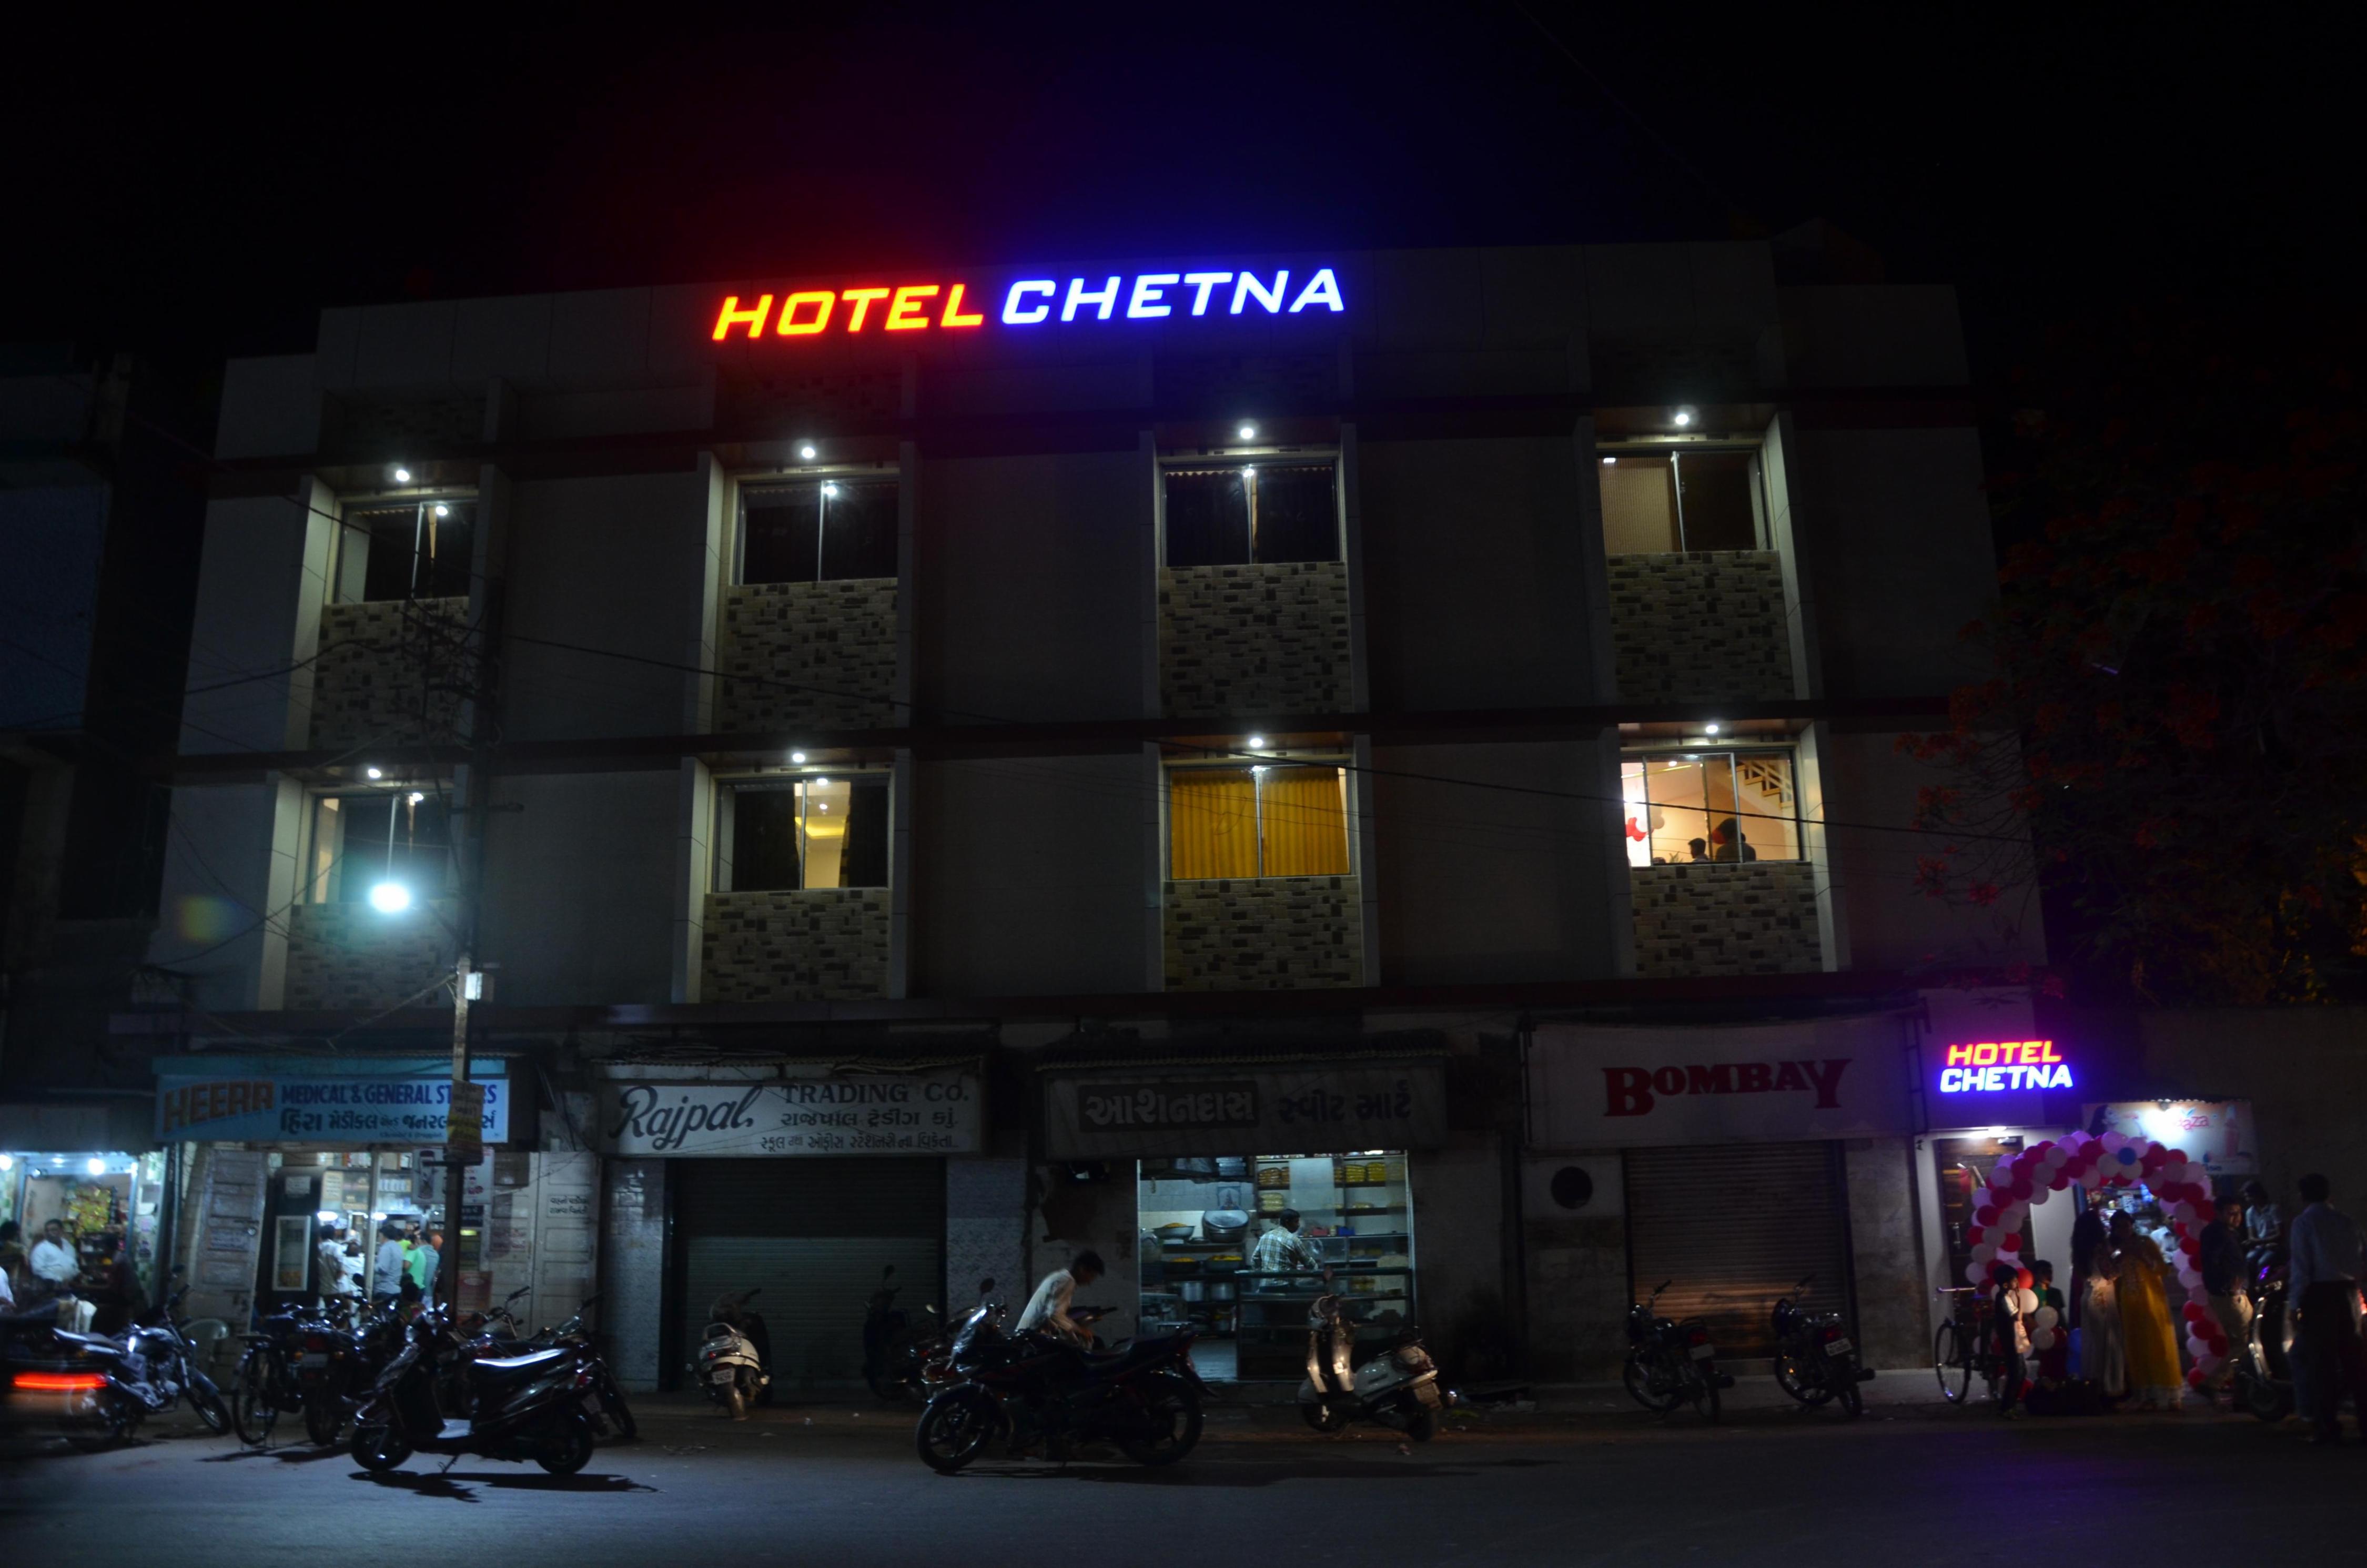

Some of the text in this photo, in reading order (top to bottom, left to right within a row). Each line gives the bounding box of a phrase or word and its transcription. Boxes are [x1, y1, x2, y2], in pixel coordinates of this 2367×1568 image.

[712, 268, 1345, 340] HOTEL CHETNA
[1947, 1040, 2062, 1067] HOTEL
[281, 1085, 348, 1104] MEDICAL
[351, 1085, 361, 1104] &
[365, 1084, 432, 1104] GENERAL
[1601, 1058, 1853, 1117] BOMBAY
[1940, 1064, 2073, 1092] CHETNA
[163, 1081, 274, 1133] HEERA
[608, 1085, 763, 1150] Rajpal
[781, 1081, 909, 1104] TRADING
[781, 1112, 858, 1127] રાજપાલ
[1085, 1079, 1411, 1126] આશનદાસ સ્વીટ માર્ટ
[281, 1108, 323, 1135] હિરા
[329, 1110, 377, 1129] મેડીકલ
